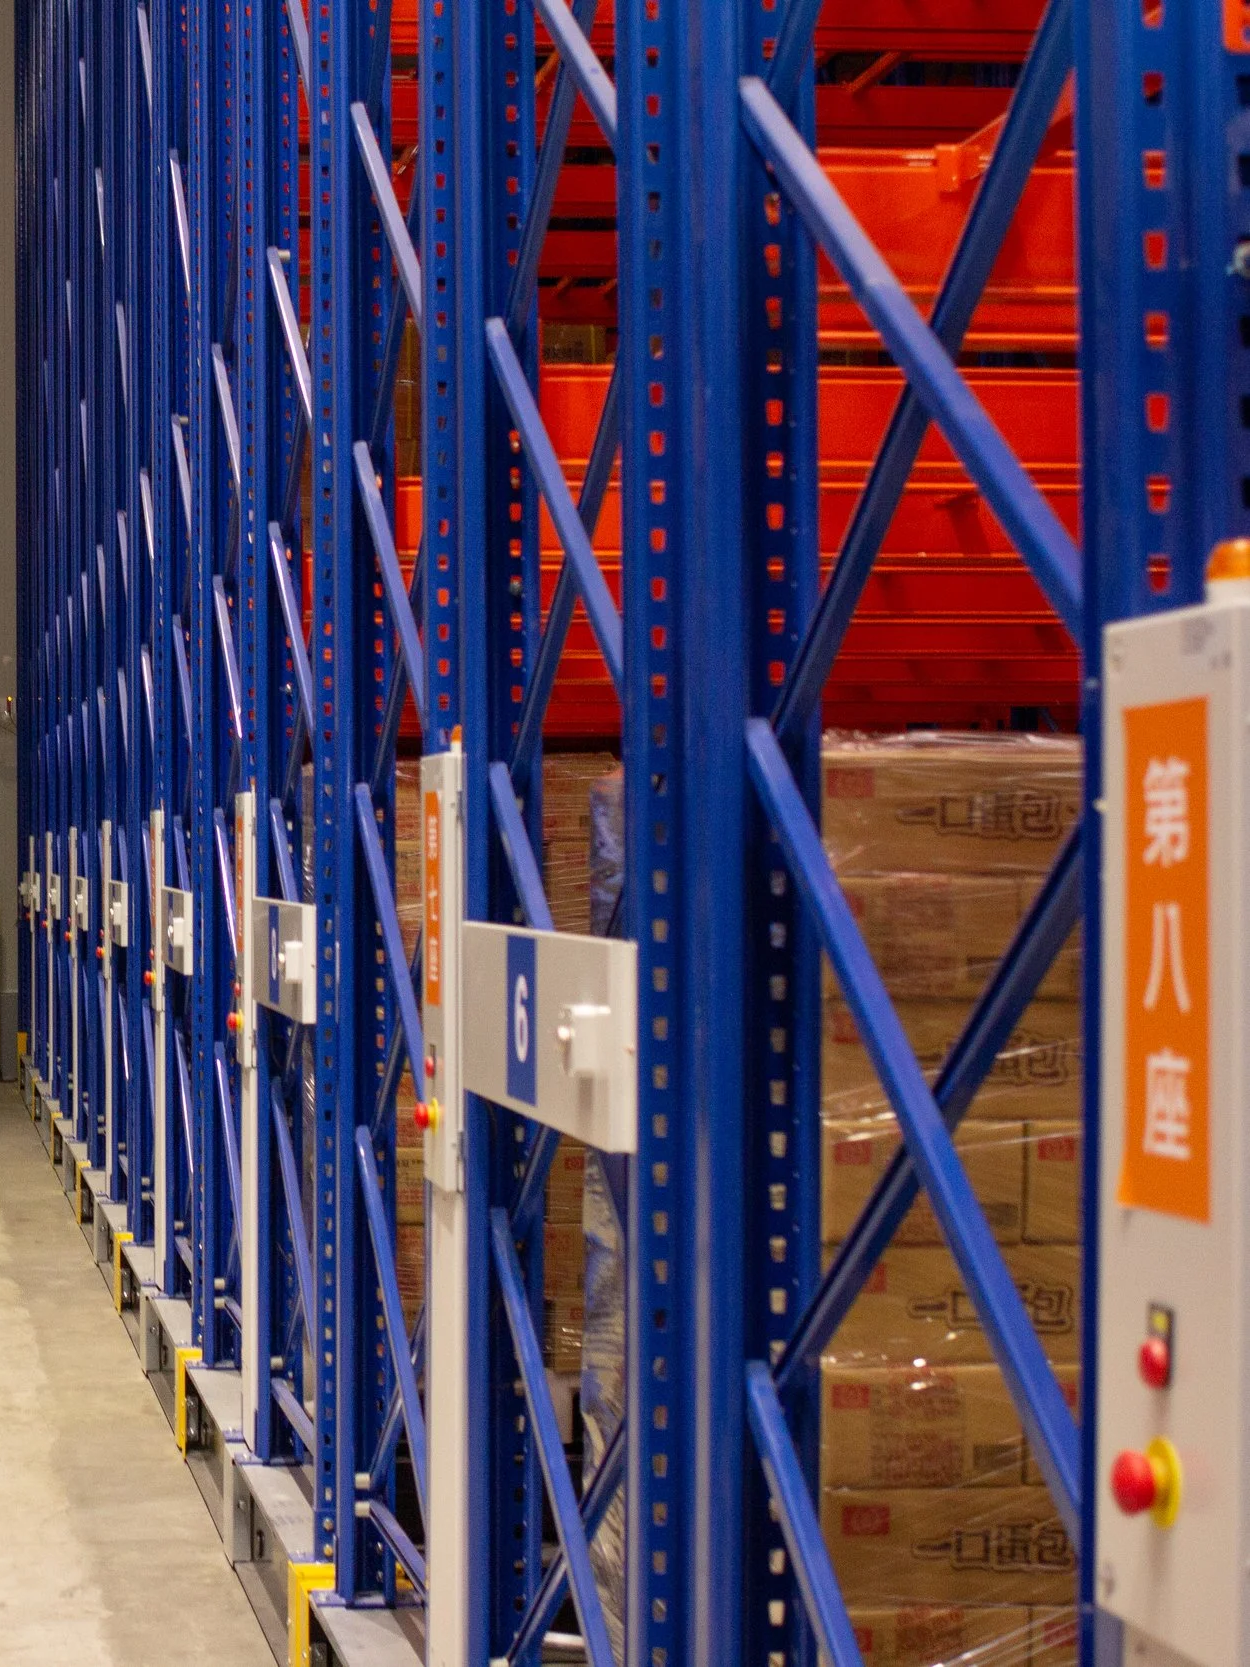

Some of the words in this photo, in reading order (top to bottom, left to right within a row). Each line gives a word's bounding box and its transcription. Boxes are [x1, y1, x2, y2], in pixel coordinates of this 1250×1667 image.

[514, 973, 529, 1064] 6
[1142, 755, 1192, 1162] 第八座
